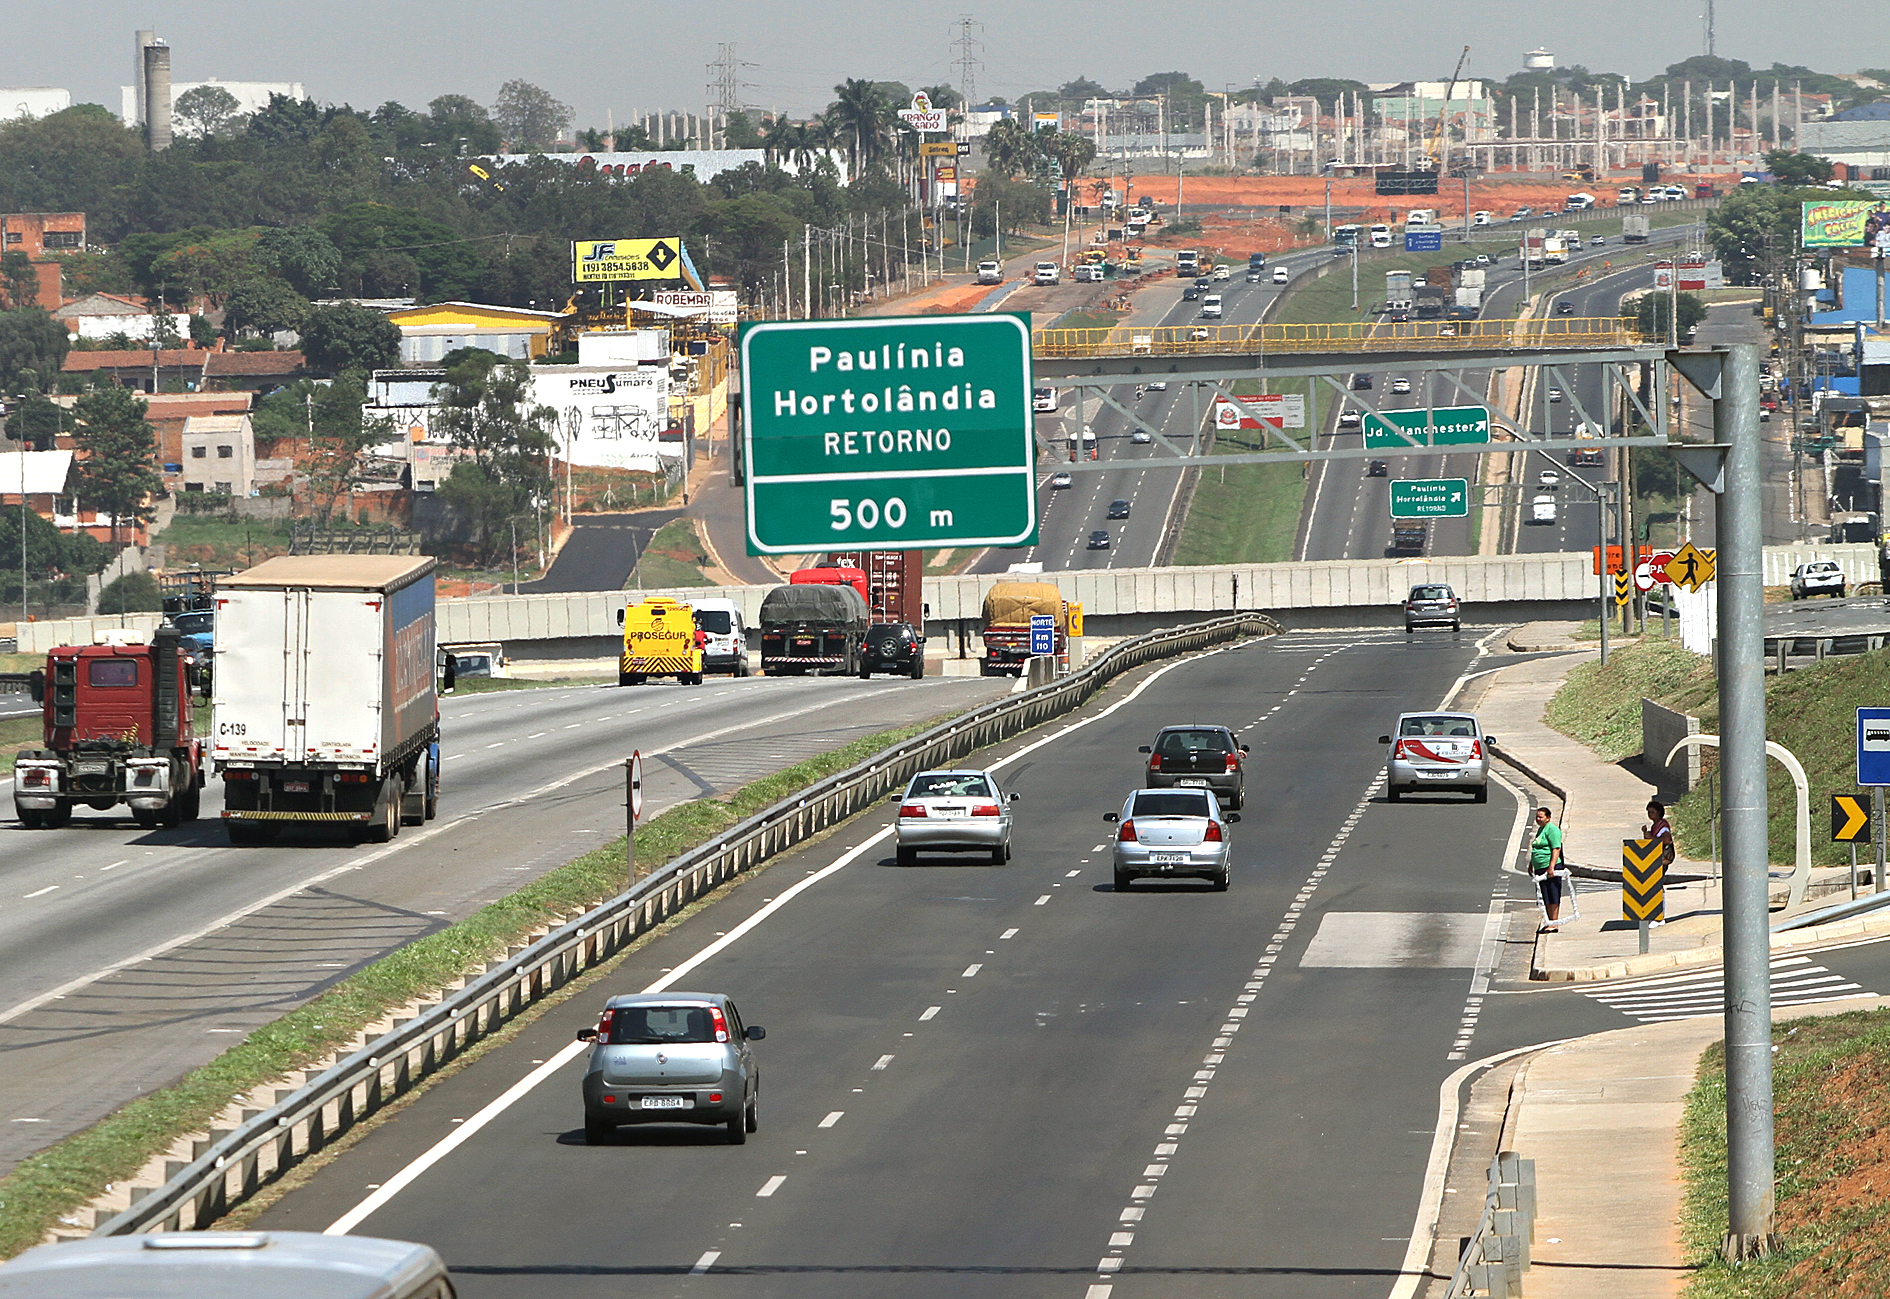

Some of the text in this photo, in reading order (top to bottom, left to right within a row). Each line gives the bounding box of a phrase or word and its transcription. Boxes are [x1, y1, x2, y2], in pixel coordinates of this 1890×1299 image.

[582, 243, 615, 262] JF
[656, 294, 711, 305] ROBEMAR
[810, 341, 965, 372] Paulínia
[774, 382, 996, 416] Hortolândia
[1366, 427, 1388, 437] Jd.
[824, 428, 951, 455] RETORNO
[1396, 495, 1446, 503] Hortolândia
[830, 497, 953, 530] 500 m
[1416, 504, 1447, 512] RETORNO
[630, 631, 686, 640] PROSEGUR
[220, 723, 246, 735] C-139
